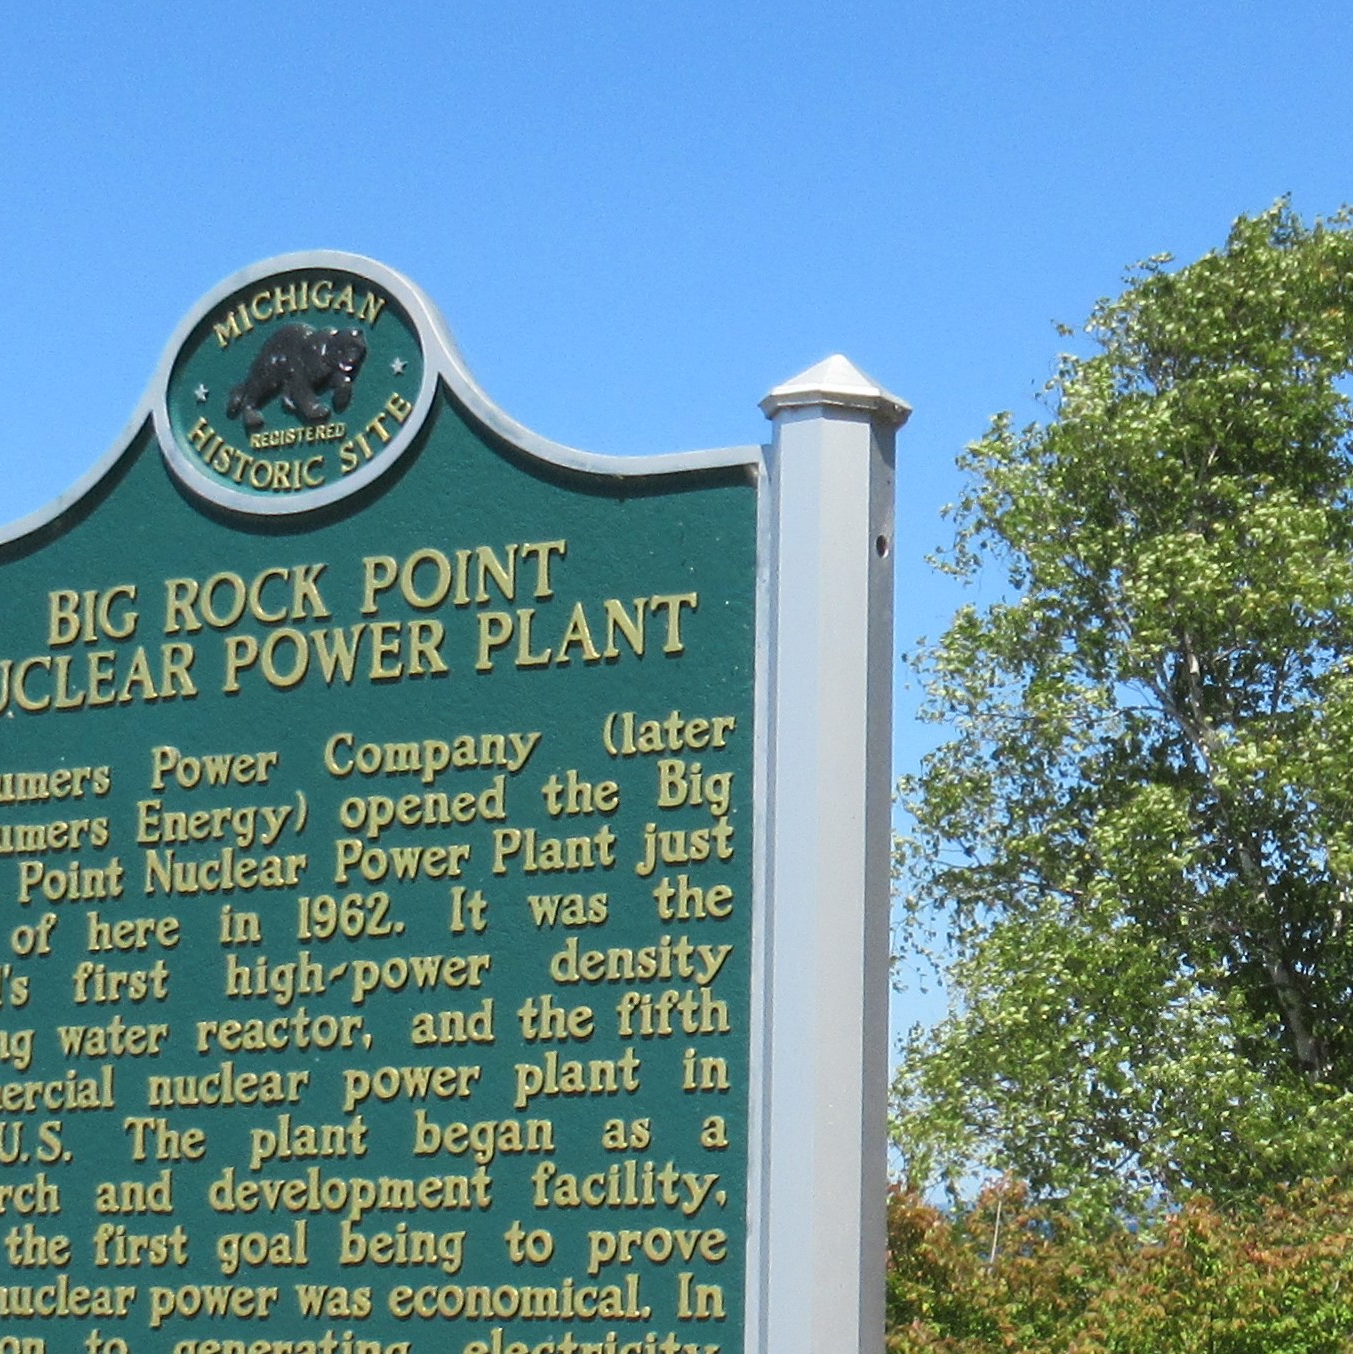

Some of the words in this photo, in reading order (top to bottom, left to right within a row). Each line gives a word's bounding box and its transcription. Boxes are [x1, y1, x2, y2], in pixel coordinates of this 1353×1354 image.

[212, 280, 385, 348] MICHIGAN
[188, 417, 325, 490] HISTORIC
[338, 392, 413, 474] SITE
[250, 422, 346, 448] REGISTERED
[48, 585, 139, 646] BIG
[163, 563, 330, 632] ROCK
[360, 539, 566, 614] POINT
[222, 618, 449, 692] POWER
[475, 592, 698, 672] PLANT
[153, 747, 277, 788] Power
[326, 733, 539, 782] Company
[604, 713, 735, 754] (later
[139, 797, 306, 847] Energy)
[341, 777, 505, 837] opened
[542, 771, 618, 814] the
[658, 760, 731, 815] Big
[20, 860, 123, 902] Point
[146, 848, 306, 892] Nuclear
[336, 840, 469, 882] Power
[494, 828, 614, 872] Plant
[636, 816, 732, 875] just
[13, 914, 57, 954] of
[89, 912, 179, 950] here
[221, 907, 261, 943] in
[299, 893, 404, 938] 1962.
[451, 888, 486, 931] It
[529, 895, 607, 924] was
[654, 876, 732, 919] the
[74, 961, 168, 1002] first
[227, 953, 490, 1005] high-power
[551, 937, 731, 984] density
[59, 1018, 167, 1055] water
[198, 1009, 371, 1051] reactor,
[412, 1000, 494, 1043] and
[519, 995, 593, 1039] the
[617, 987, 729, 1035] fifth
[150, 1063, 308, 1106] nuclear
[344, 1067, 480, 1111] power
[515, 1049, 639, 1107] plant
[683, 1049, 728, 1089] in
[125, 1118, 205, 1159] The
[251, 1115, 366, 1169] plant
[415, 1111, 553, 1164] began
[603, 1120, 650, 1149] as
[701, 1117, 728, 1147] a
[97, 1171, 172, 1212] and
[209, 1166, 490, 1226] development
[532, 1161, 726, 1214] facility,
[6, 1225, 69, 1265] the
[94, 1224, 187, 1265] first
[218, 1221, 308, 1274] goal
[340, 1224, 465, 1273] being
[505, 1223, 553, 1262] to
[588, 1229, 726, 1273] prove
[151, 1286, 277, 1327] power
[297, 1286, 371, 1317] was
[389, 1275, 650, 1318] economical.
[678, 1273, 724, 1318] In
